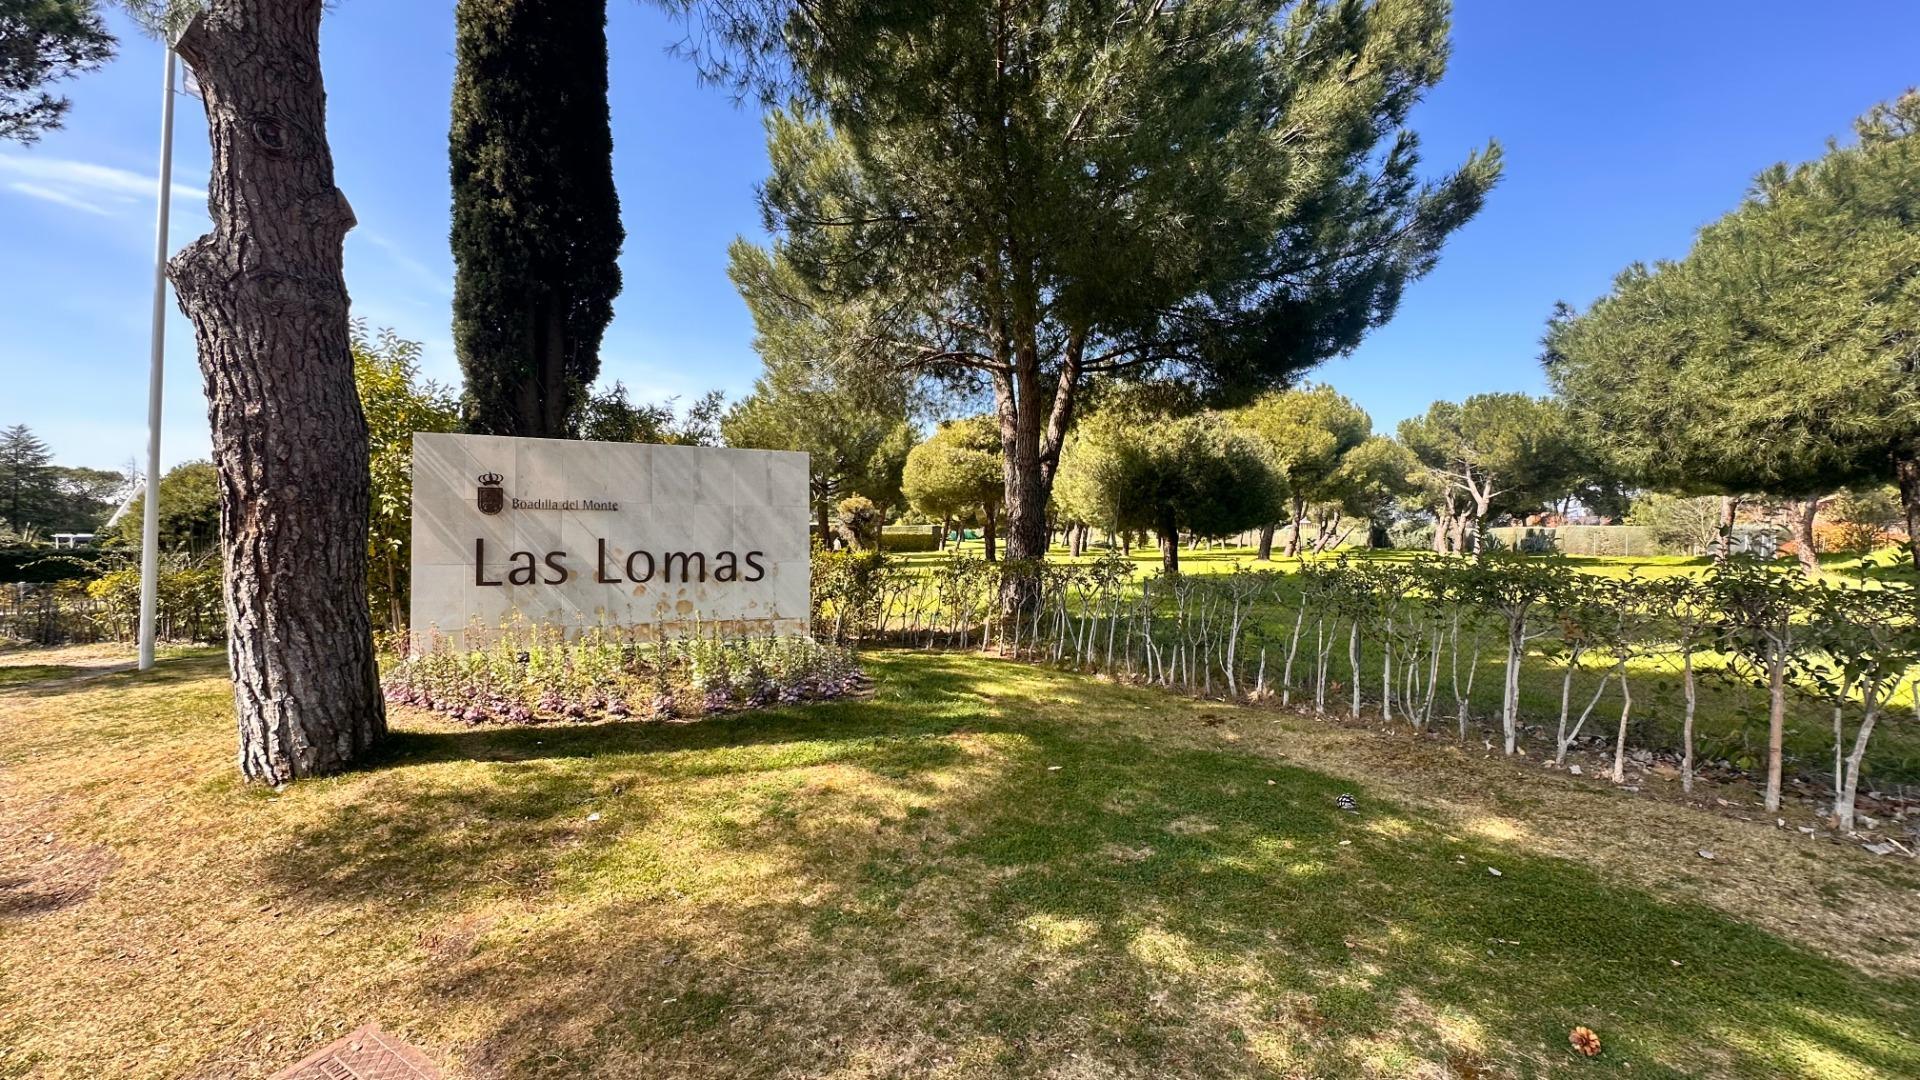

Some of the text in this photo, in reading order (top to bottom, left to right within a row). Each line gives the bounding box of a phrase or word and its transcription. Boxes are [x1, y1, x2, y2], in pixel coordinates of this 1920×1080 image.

[512, 498, 619, 511] Boadilla del Monte
[475, 538, 766, 587] Las Lomas
